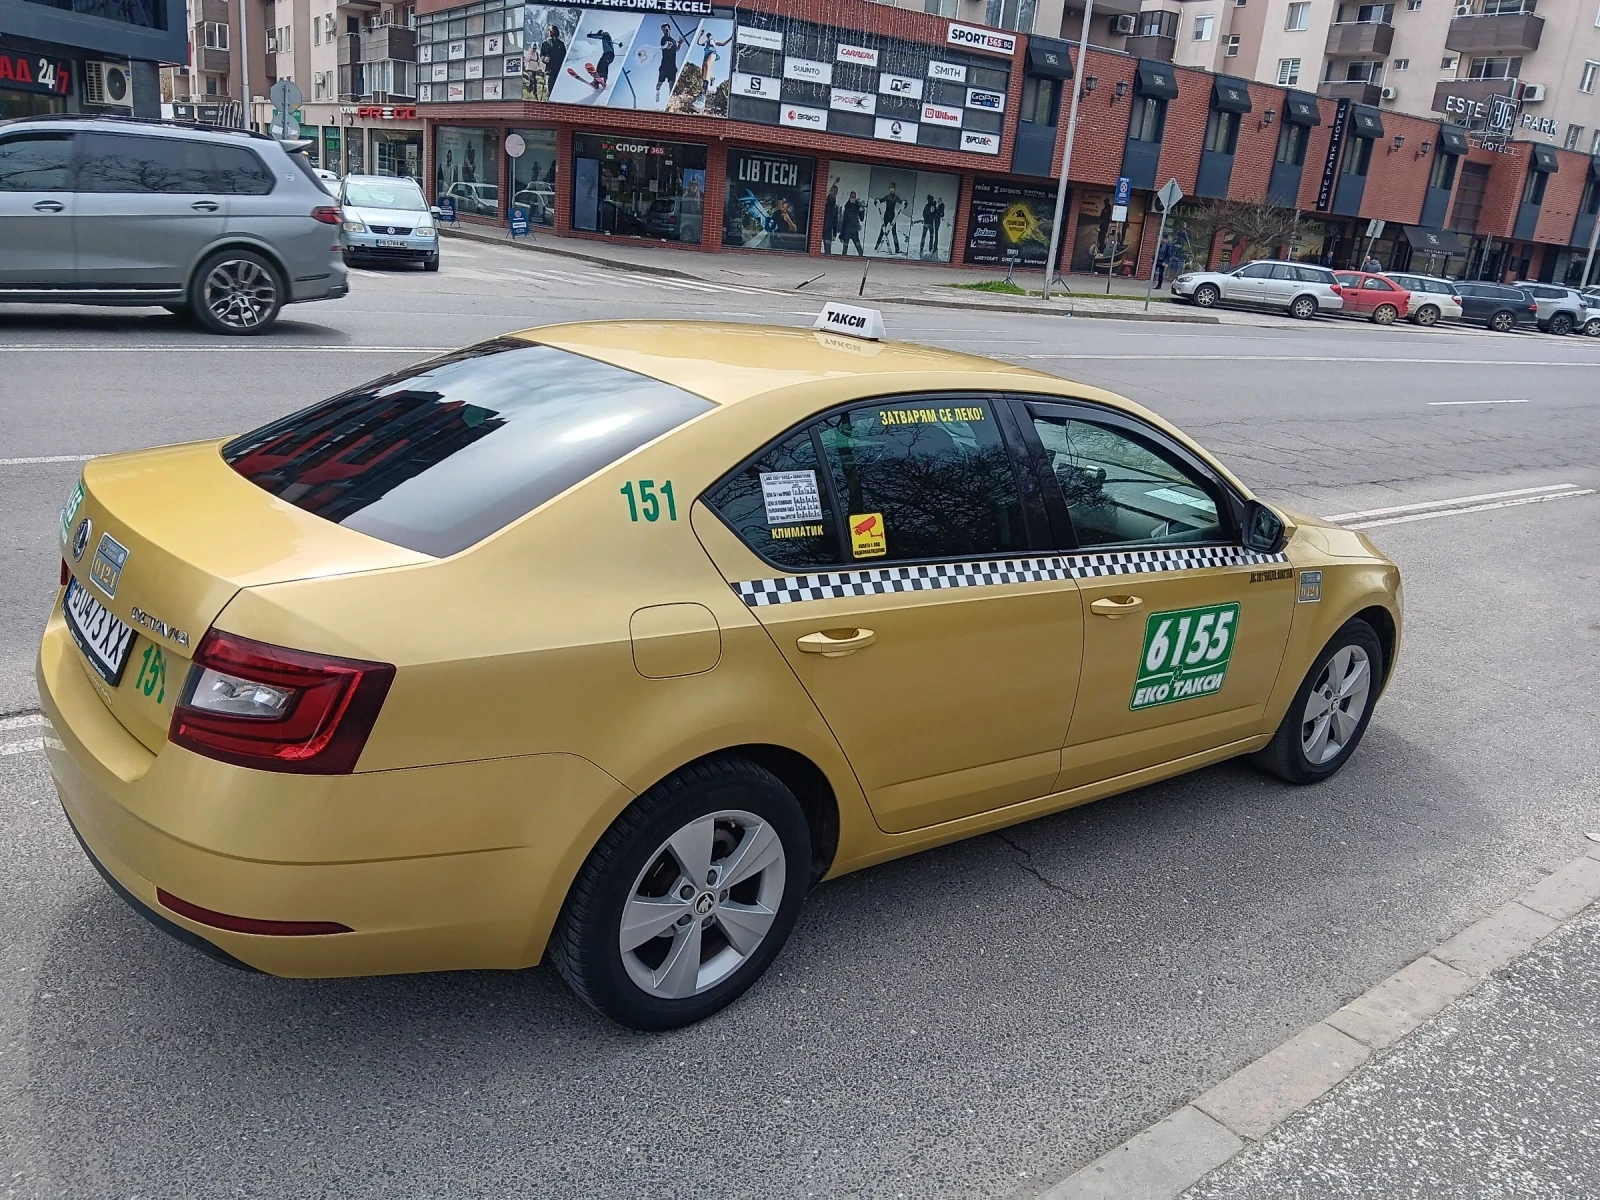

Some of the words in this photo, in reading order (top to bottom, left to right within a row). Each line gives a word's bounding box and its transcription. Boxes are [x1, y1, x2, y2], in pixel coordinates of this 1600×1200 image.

[665, 2, 711, 13] EXCEL.
[951, 28, 987, 46] SPORT
[840, 48, 874, 60] CARRERA
[38, 58, 69, 95] 24/7
[793, 65, 820, 75] SUUNTO
[934, 65, 961, 78] SMITH
[971, 92, 999, 103] GoPro
[797, 113, 820, 122] BRIKO
[934, 110, 959, 122] Wilson
[1445, 95, 1484, 118] ESTE
[1520, 113, 1559, 135] PARK
[616, 143, 649, 154] СПОРТ
[651, 147, 664, 155] 365
[1319, 179, 1330, 207] ESTE
[1326, 145, 1337, 175] PARK
[1334, 104, 1346, 141] HOTEL
[1481, 141, 1508, 154] HOTEL
[739, 158, 760, 182] LIB
[764, 162, 798, 186] TECH
[827, 311, 866, 328] ТАКСИ
[880, 409, 937, 425] ЗАТВАРЯМ
[939, 408, 953, 422] СЕ
[954, 407, 984, 422] ЛЕКО!
[620, 480, 677, 522] 151
[771, 525, 824, 539] КЛИМАТИК
[94, 557, 117, 589] 0424
[131, 606, 190, 648] OCTAVIA
[1146, 610, 1234, 672] 6155
[1133, 685, 1170, 705] ЕКО
[1172, 672, 1225, 698] ТАКСИ
